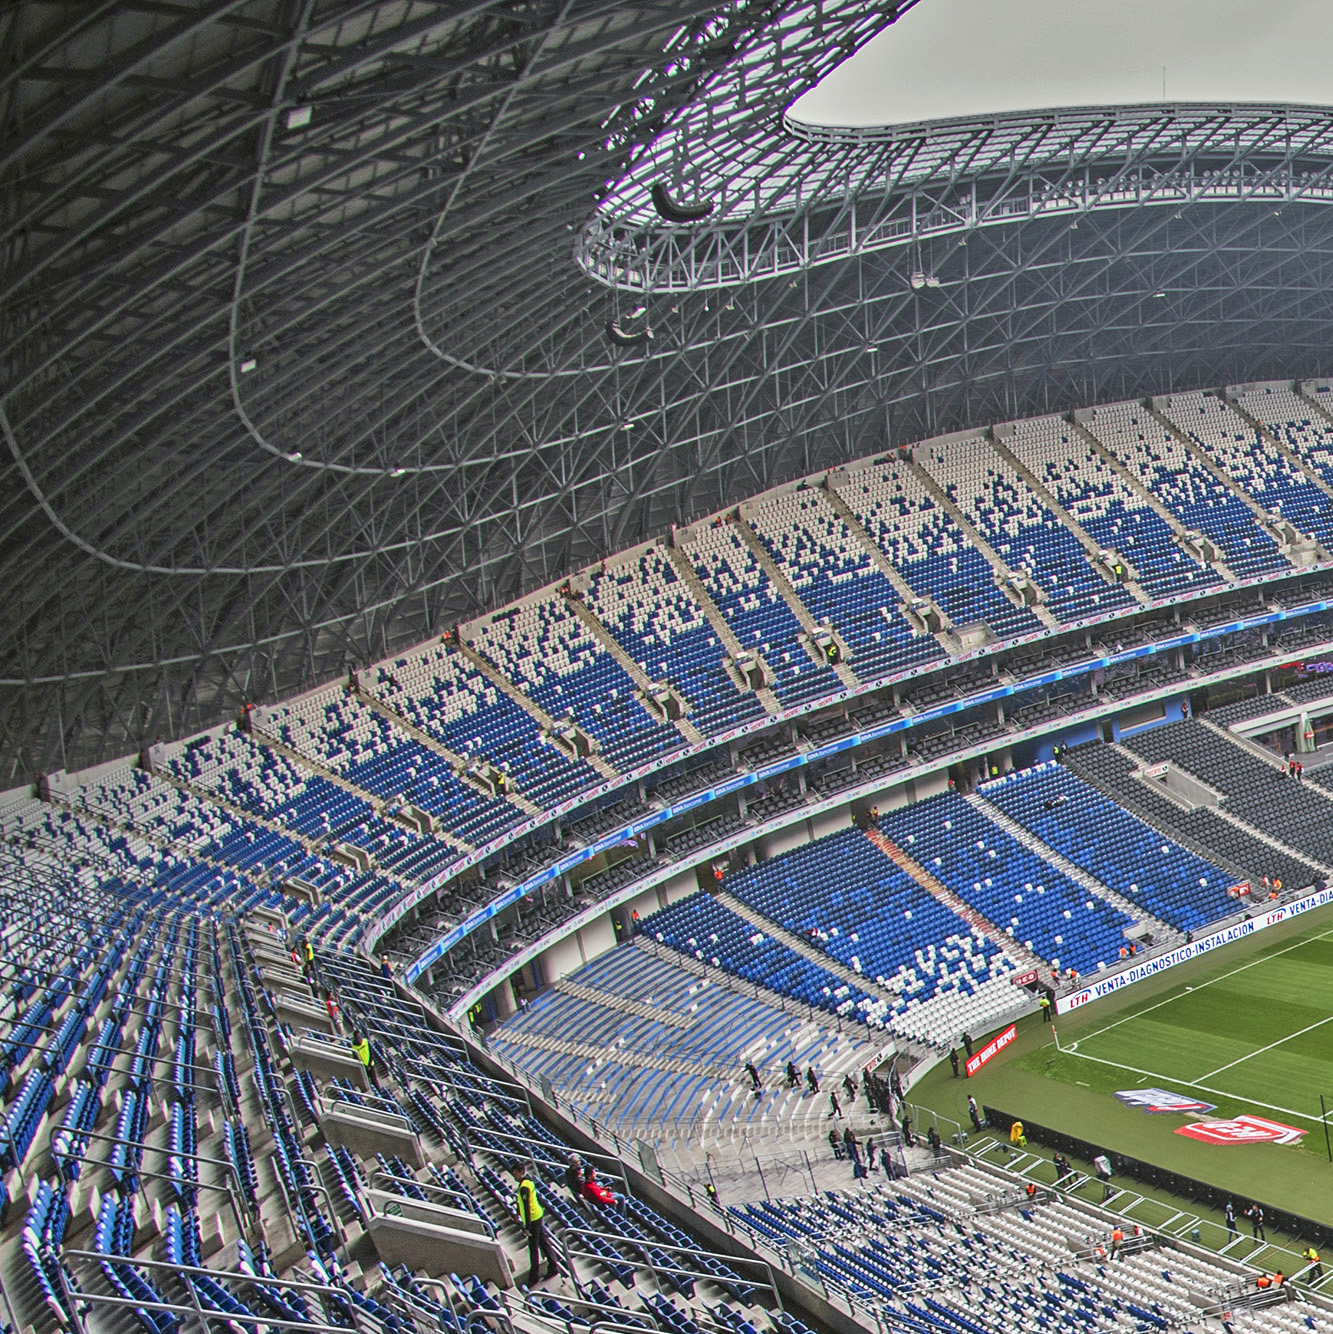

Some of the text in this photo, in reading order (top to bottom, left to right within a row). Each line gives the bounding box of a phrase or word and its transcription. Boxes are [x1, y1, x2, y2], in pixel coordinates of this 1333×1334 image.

[1267, 911, 1284, 925] LTH
[1070, 921, 1255, 1008] LTH VENTA-DIAGNOSTICO-INSTALACION
[967, 1027, 1016, 1073] THE HOME DEPOT
